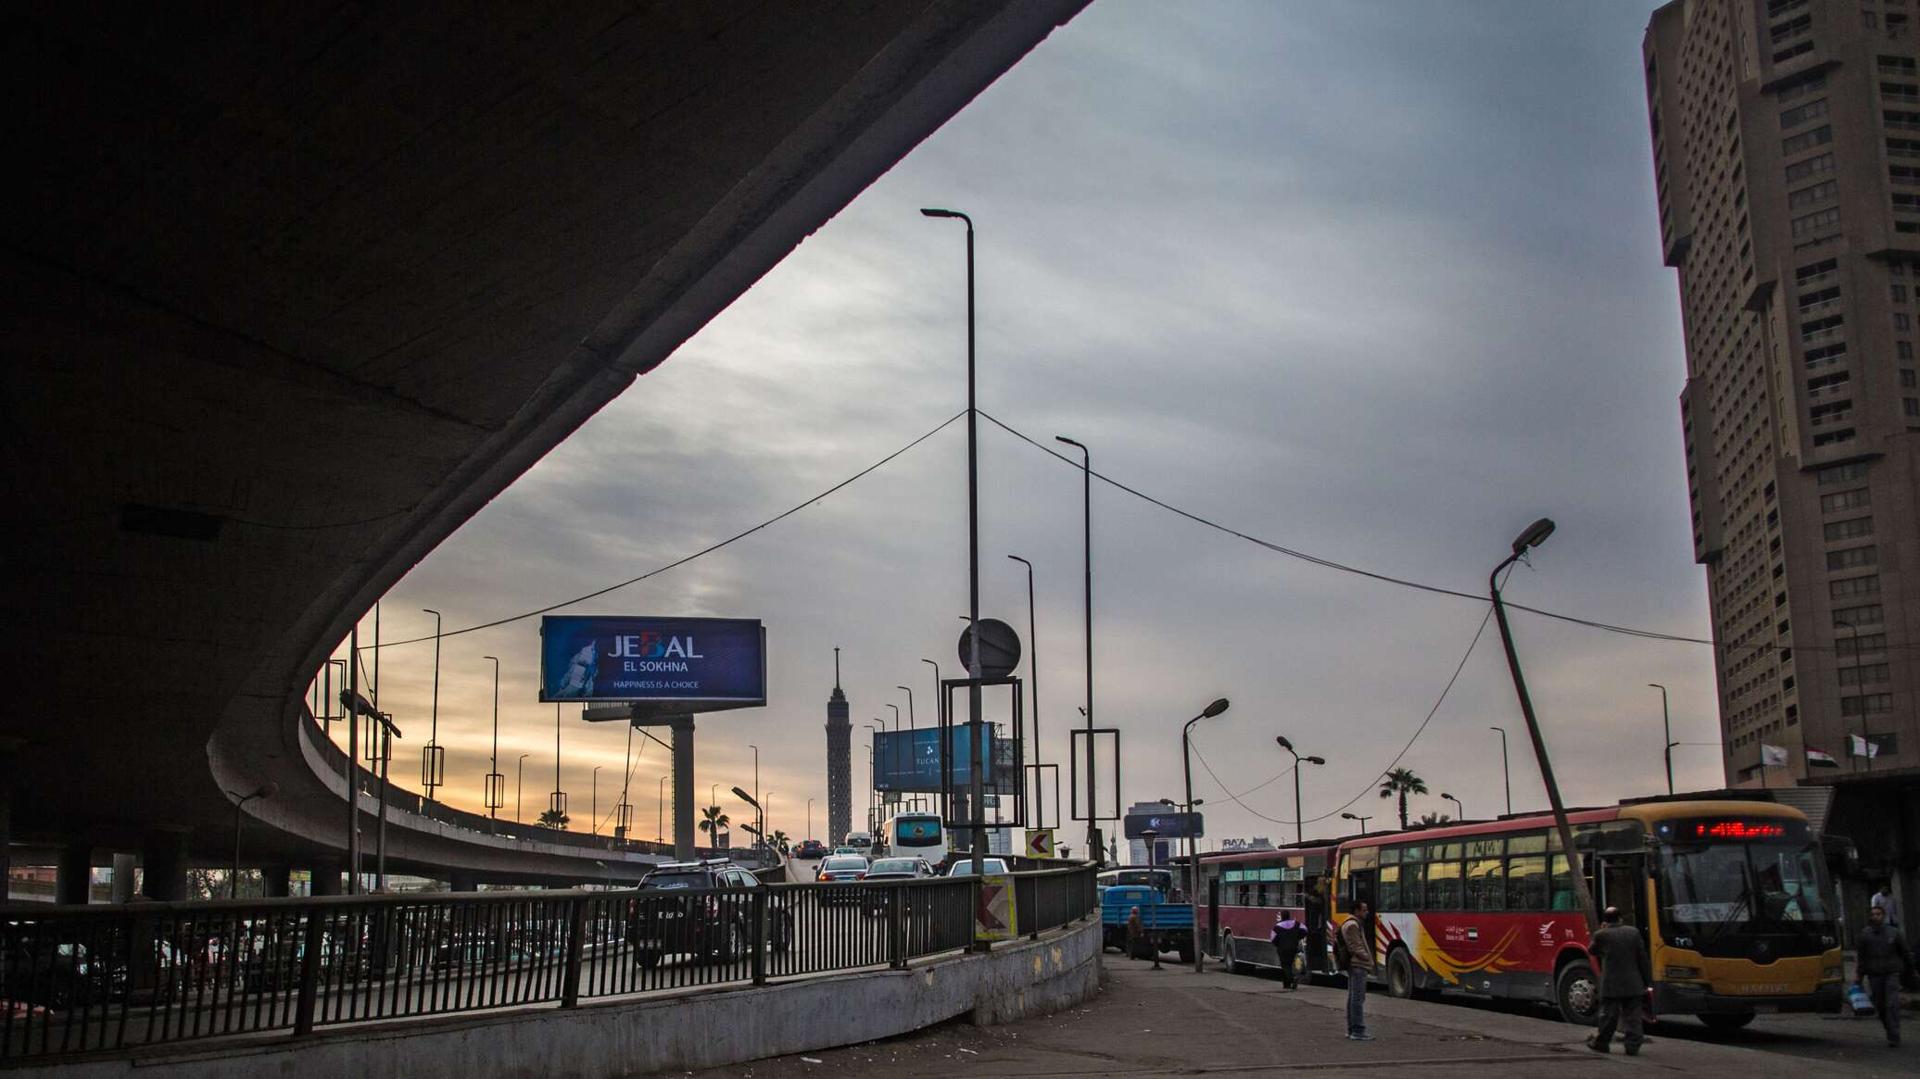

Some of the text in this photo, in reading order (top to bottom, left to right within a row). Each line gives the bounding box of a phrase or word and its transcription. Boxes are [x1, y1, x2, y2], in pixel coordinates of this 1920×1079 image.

[607, 632, 704, 658] JEBAL
[623, 661, 688, 671] EL SOKHNA
